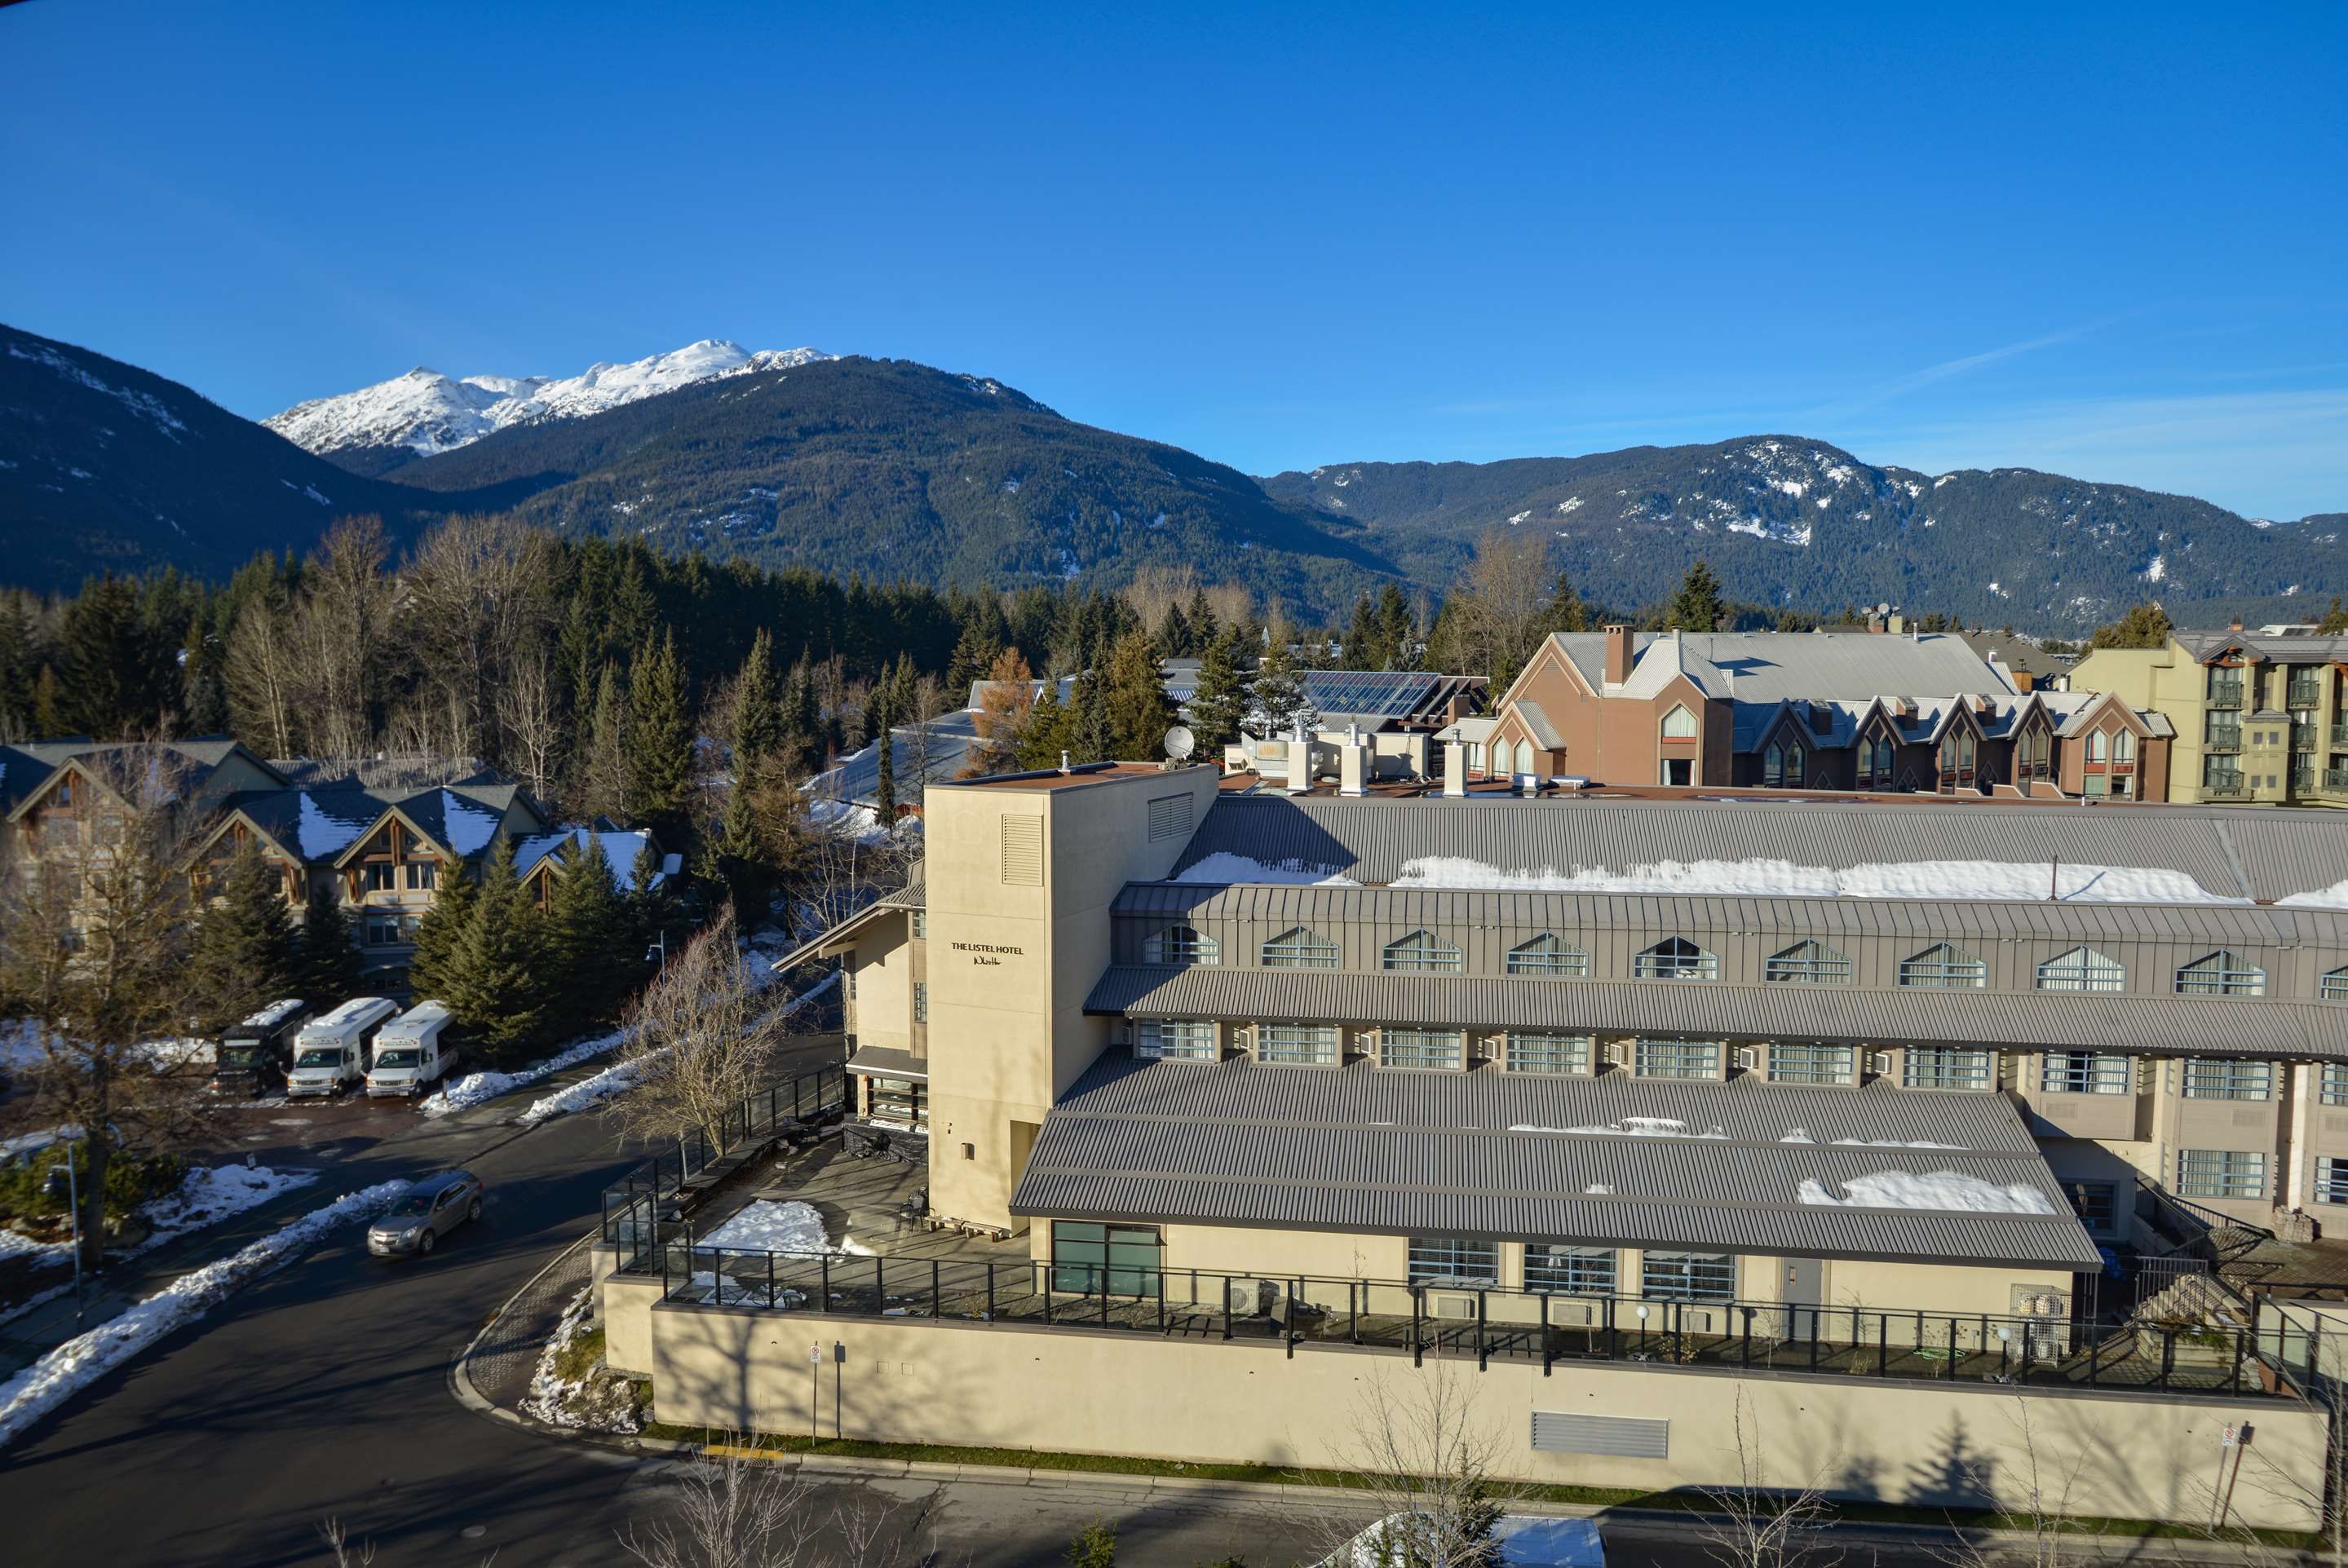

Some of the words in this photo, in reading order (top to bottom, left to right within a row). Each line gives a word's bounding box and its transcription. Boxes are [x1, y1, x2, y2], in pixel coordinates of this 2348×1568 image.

[951, 942, 967, 951] THE
[968, 943, 995, 953] LISTEL
[996, 946, 1024, 955] HOTEL
